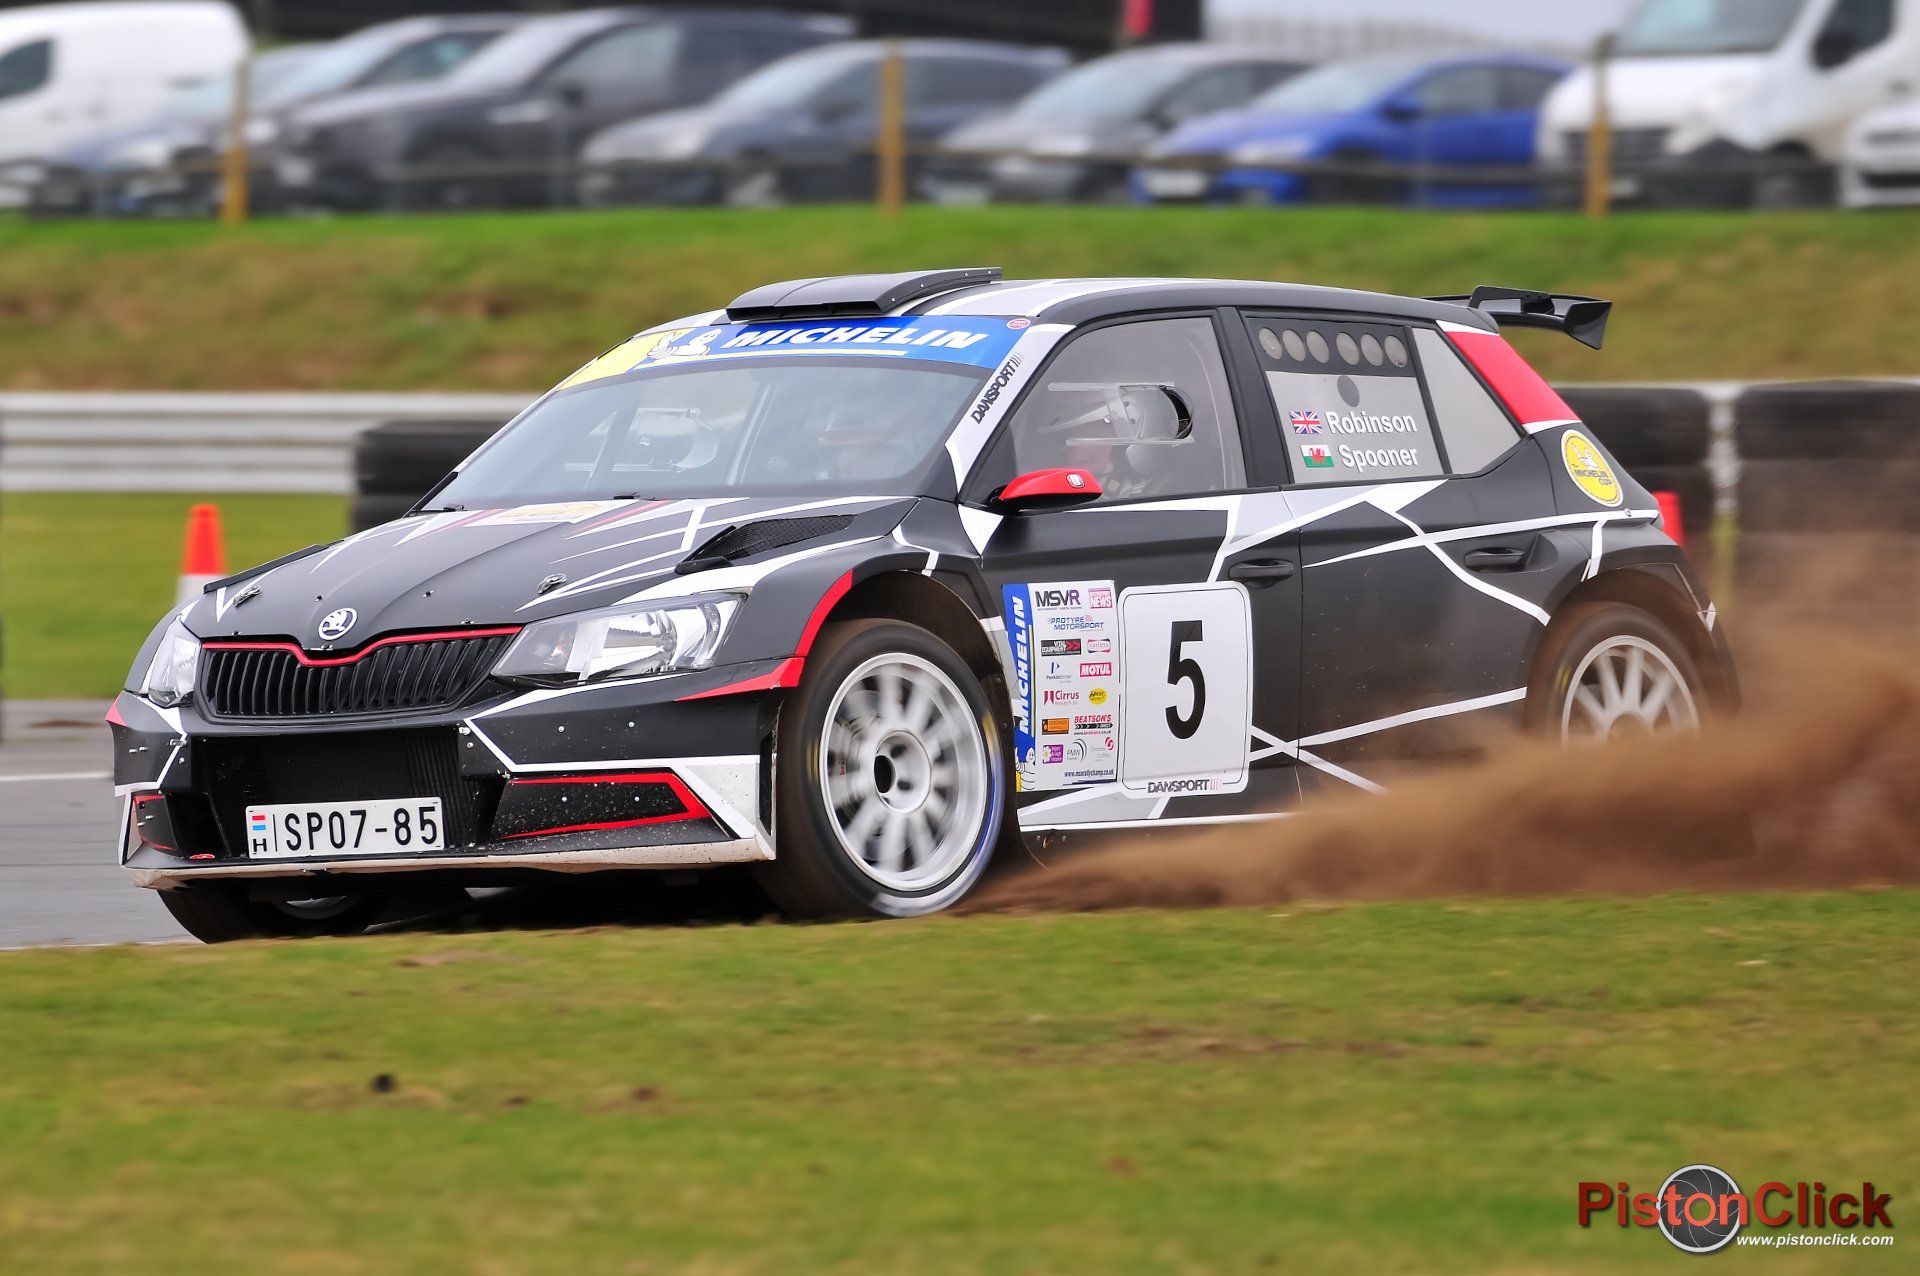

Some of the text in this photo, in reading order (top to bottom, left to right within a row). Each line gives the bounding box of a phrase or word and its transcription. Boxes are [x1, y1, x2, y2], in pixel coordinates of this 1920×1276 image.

[720, 327, 989, 349] MICHELIN
[971, 361, 1016, 424] DANSPORT
[1325, 411, 1417, 434] Robinson
[1338, 444, 1418, 472] Spooner
[1035, 589, 1081, 607] MSVR
[1090, 596, 1112, 608] NEWS
[1050, 616, 1085, 624] PROTYRE
[1054, 622, 1104, 631] MOTORSPORT
[1012, 596, 1029, 735] MICHELIN
[1081, 664, 1111, 676] MOTUL
[1165, 620, 1206, 739] 5
[1055, 690, 1080, 701] Cirrus
[1074, 715, 1112, 724] BEATSON'S
[1147, 779, 1210, 793] DANSPORT
[253, 806, 437, 852] H SP07-85
